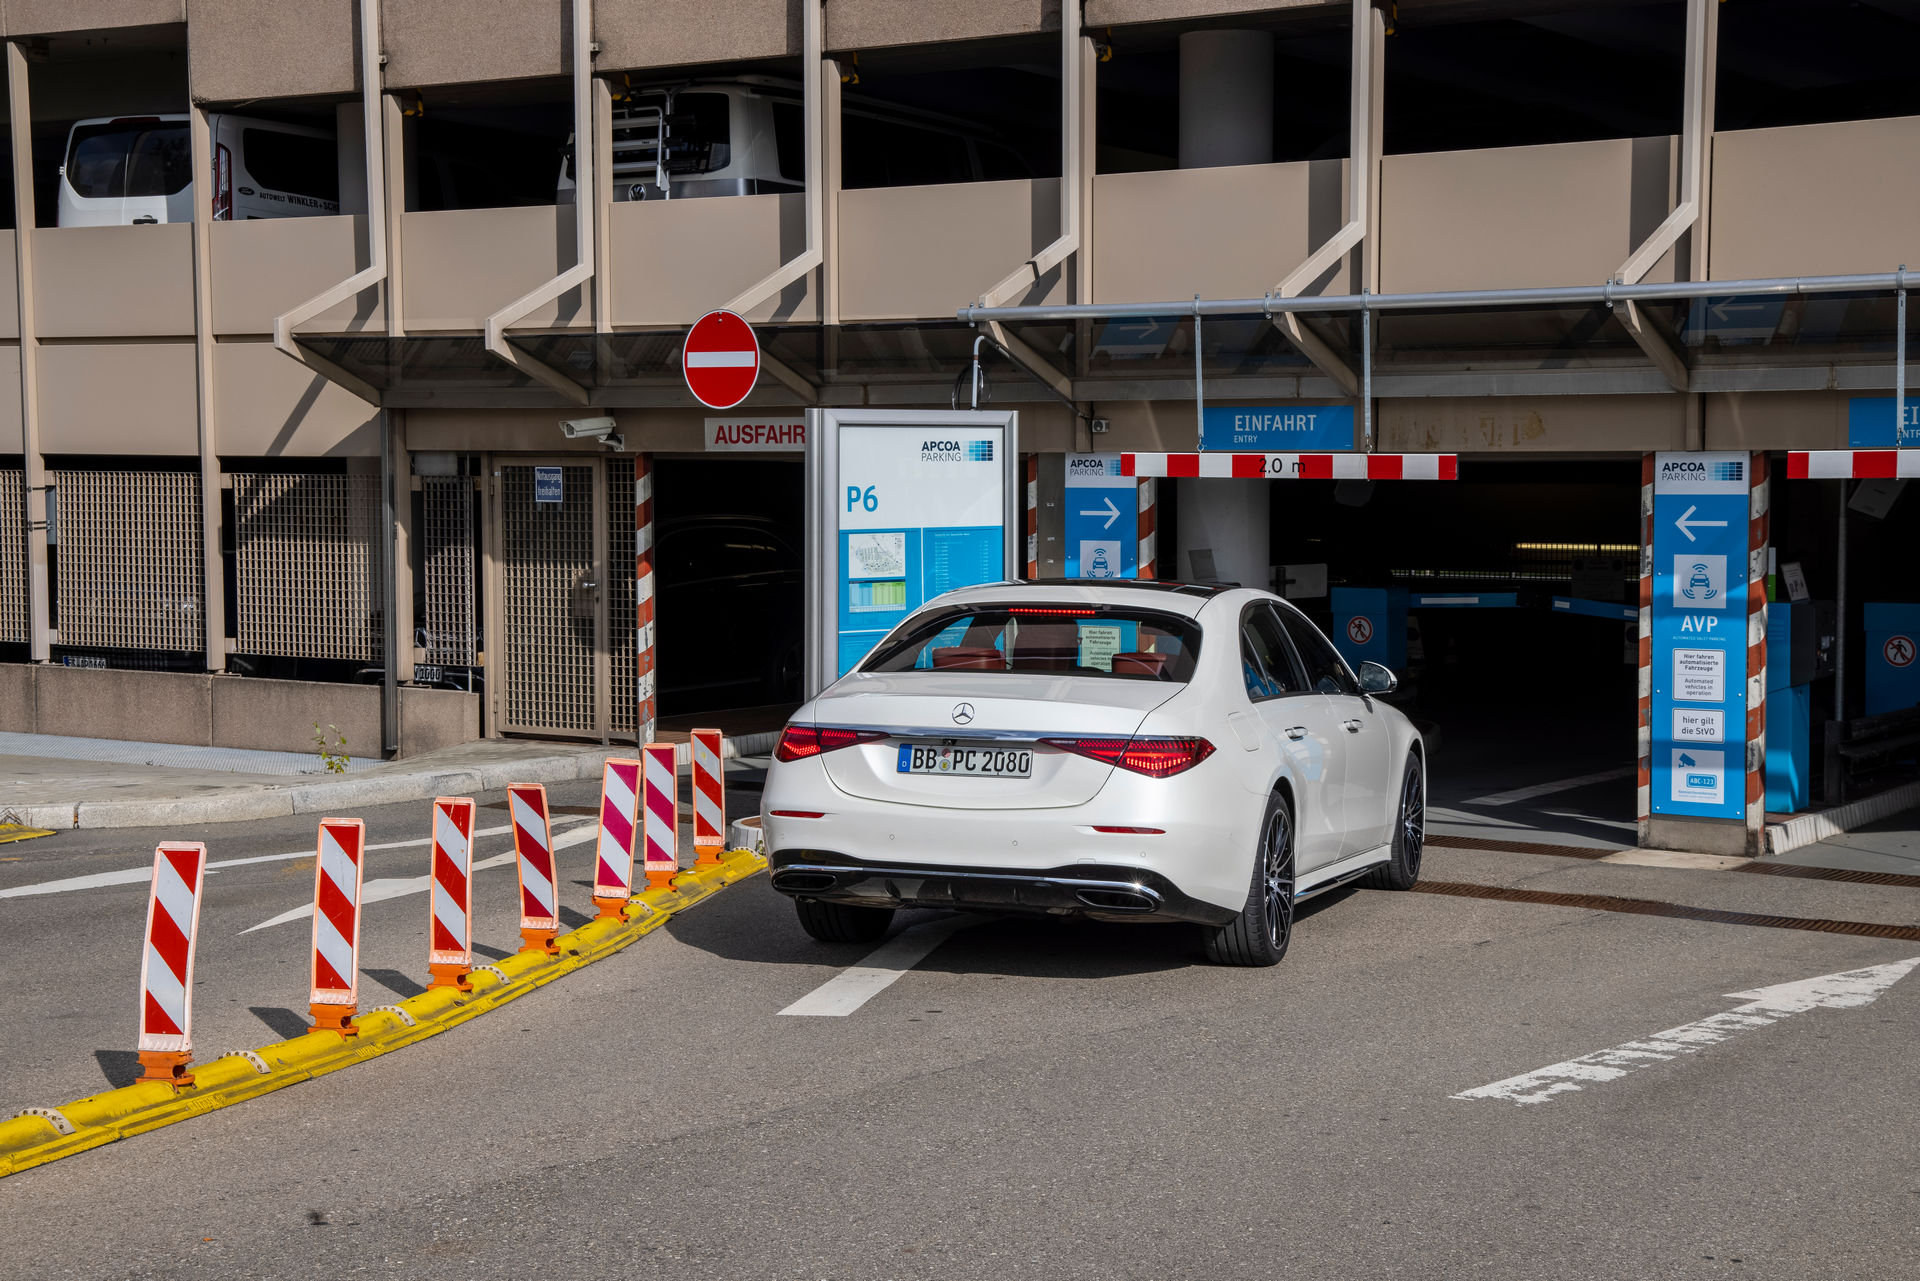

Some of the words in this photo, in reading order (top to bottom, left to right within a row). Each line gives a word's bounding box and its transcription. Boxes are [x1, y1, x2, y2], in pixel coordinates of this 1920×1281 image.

[1234, 414, 1317, 432] EINFAHRT
[714, 424, 805, 445] AUSFAHR
[1233, 435, 1258, 443] ENTRY
[921, 440, 961, 452] APCOA
[921, 452, 962, 462] PARKING
[1070, 459, 1104, 468] APCOA
[1291, 461, 1306, 473] m
[1662, 462, 1705, 472] APCOA
[1069, 468, 1104, 476] PARKING
[1661, 472, 1706, 481] PARKING
[846, 485, 879, 513] P6
[1680, 615, 1718, 632] AVP
[1682, 716, 1698, 724] hier
[1700, 717, 1714, 726] gilt
[1696, 728, 1715, 736] StVO
[912, 748, 937, 770] BB
[952, 750, 976, 771] PC
[981, 751, 1030, 773] 2080
